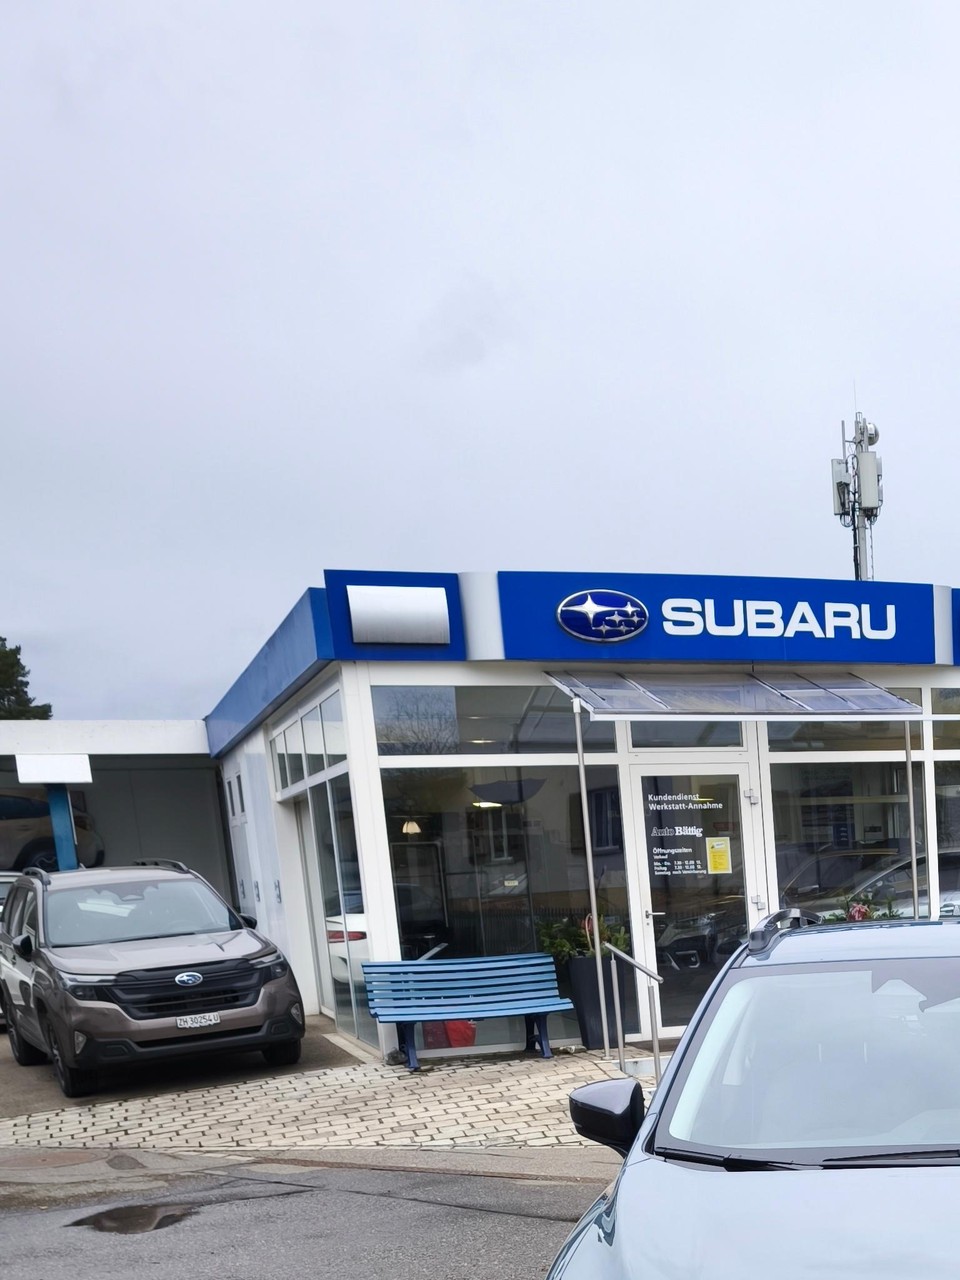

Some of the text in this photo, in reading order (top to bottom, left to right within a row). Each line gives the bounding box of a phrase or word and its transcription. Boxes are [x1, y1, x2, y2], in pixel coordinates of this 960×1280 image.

[661, 597, 897, 640] SUBARU
[647, 793, 700, 801] Kundendienst
[648, 802, 723, 811] Werkstatt-Annahme
[651, 825, 703, 837] Auto Bättig
[652, 847, 693, 855] Öffnungszeiten
[178, 1018, 188, 1026] ZH
[213, 1014, 219, 1022] U
